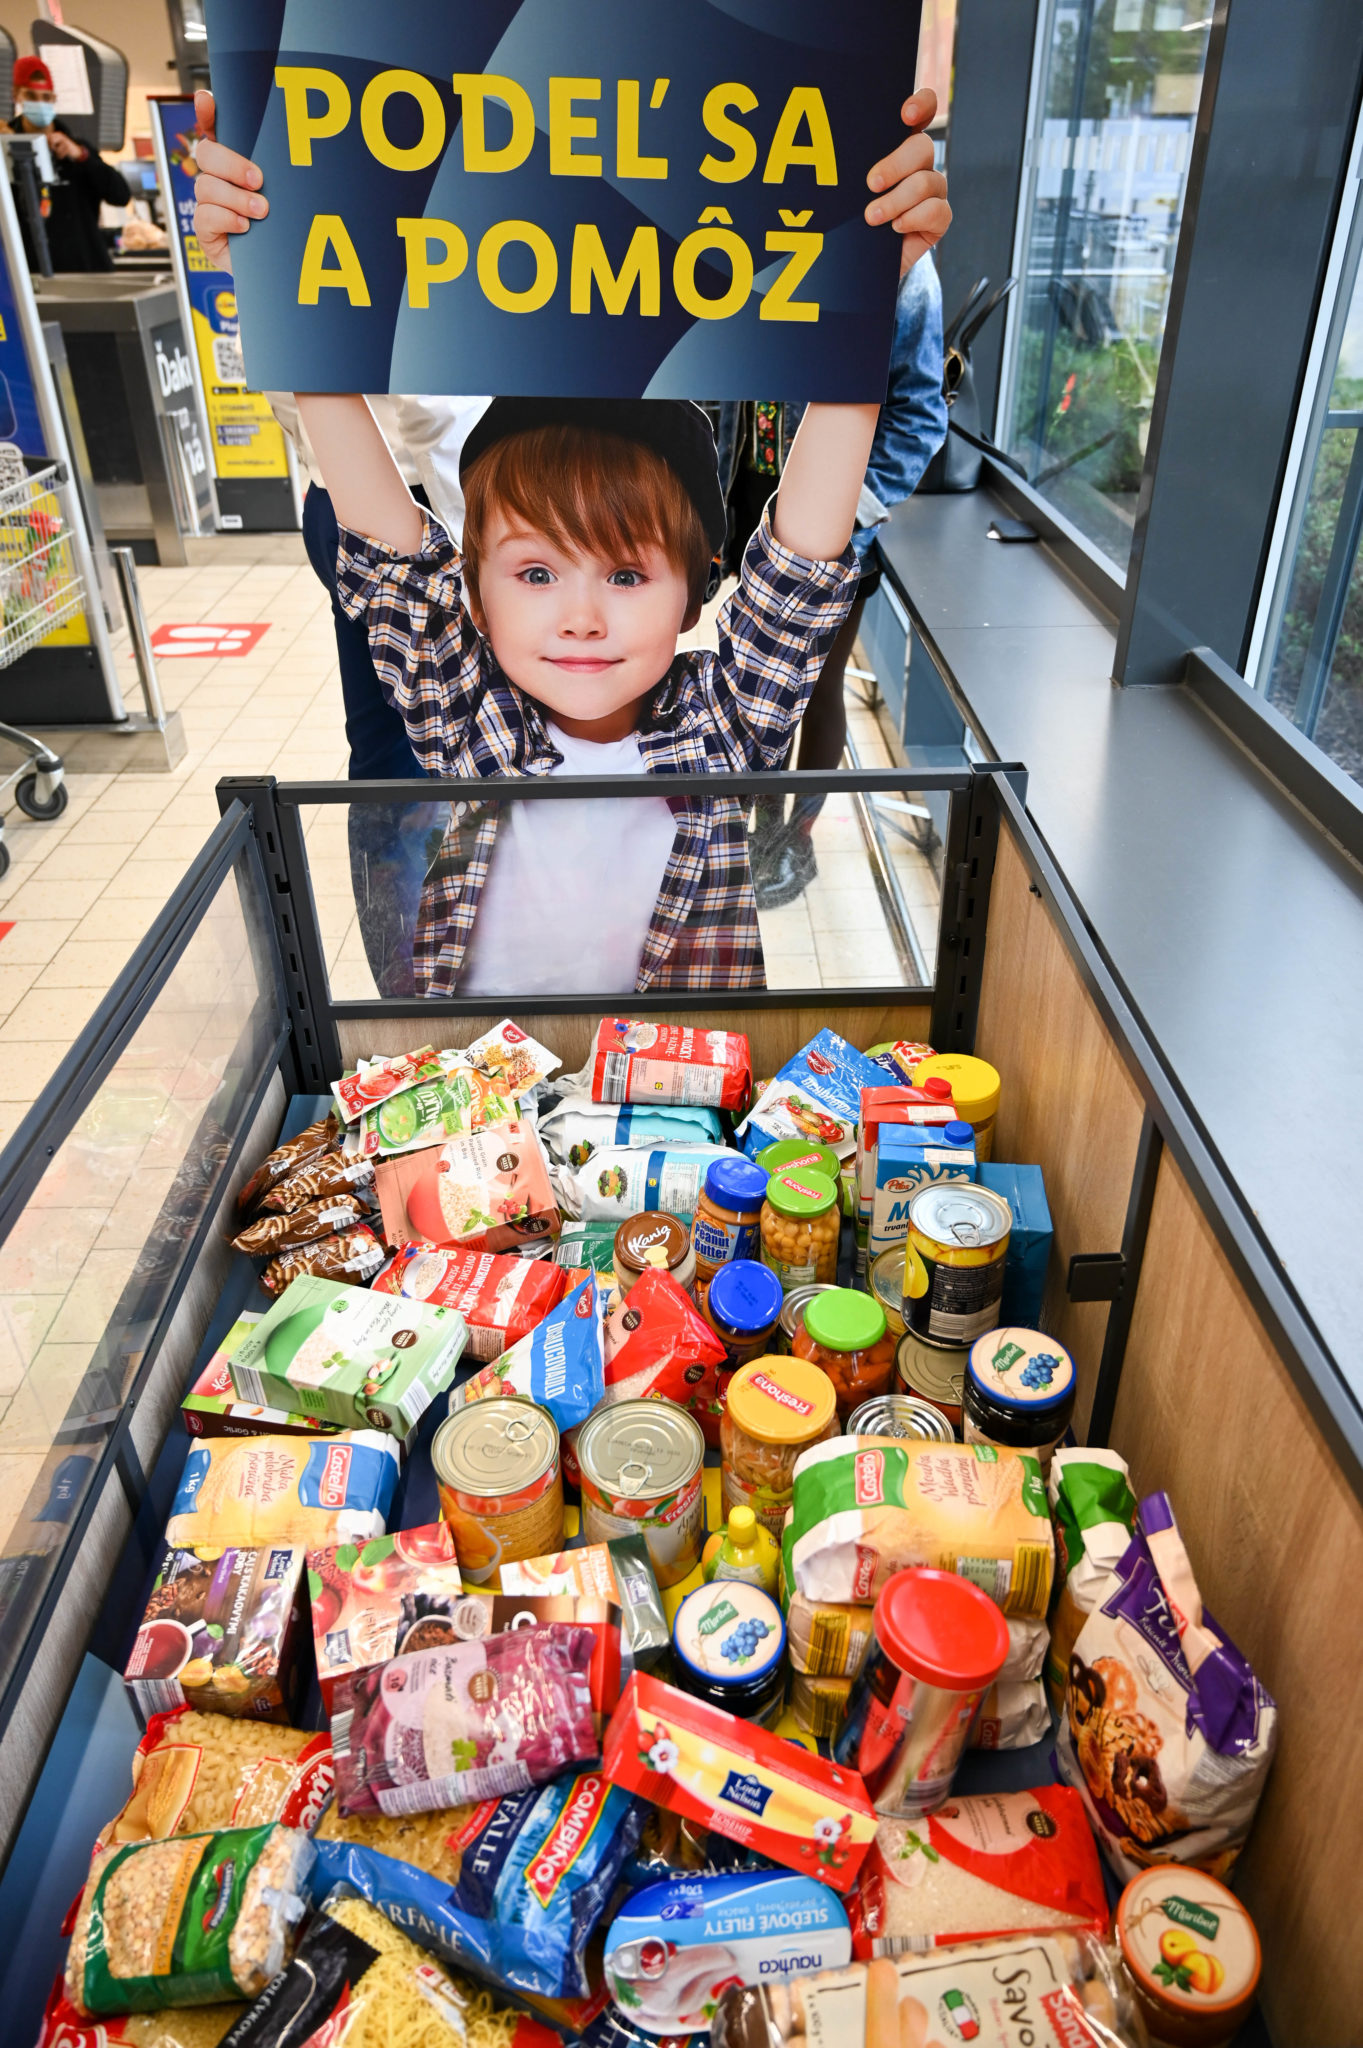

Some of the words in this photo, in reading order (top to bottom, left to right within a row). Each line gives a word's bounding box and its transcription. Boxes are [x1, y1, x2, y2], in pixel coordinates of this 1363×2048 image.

[274, 66, 670, 180] PODEĽ
[699, 82, 838, 186] SA
[297, 214, 371, 307] A
[396, 206, 824, 322] POMÔŽ
[784, 1179, 821, 1200] Freshona
[695, 1221, 730, 1248] Peanut
[700, 1219, 725, 1238] Smooth
[694, 1241, 728, 1260] Butter
[753, 1374, 811, 1417] Freshona
[185, 1478, 200, 1492] kg
[329, 1449, 346, 1504] Castello
[232, 1551, 248, 1576] BOBY
[269, 1552, 281, 1577] Nelson
[278, 1555, 289, 1573] Lord
[855, 1548, 874, 1597] Castello
[226, 1575, 251, 1635] KAKAOVÝMI
[725, 1785, 762, 1812] Nelson
[734, 1775, 762, 1798] Lord
[473, 1789, 529, 1875] FALLE
[534, 1777, 602, 1883] COMBINO
[703, 1917, 755, 1937] FILETY
[759, 1907, 829, 1934] SLEĎOVÉ
[758, 1953, 823, 1976] nautica
[992, 1966, 1037, 2048] Savo
